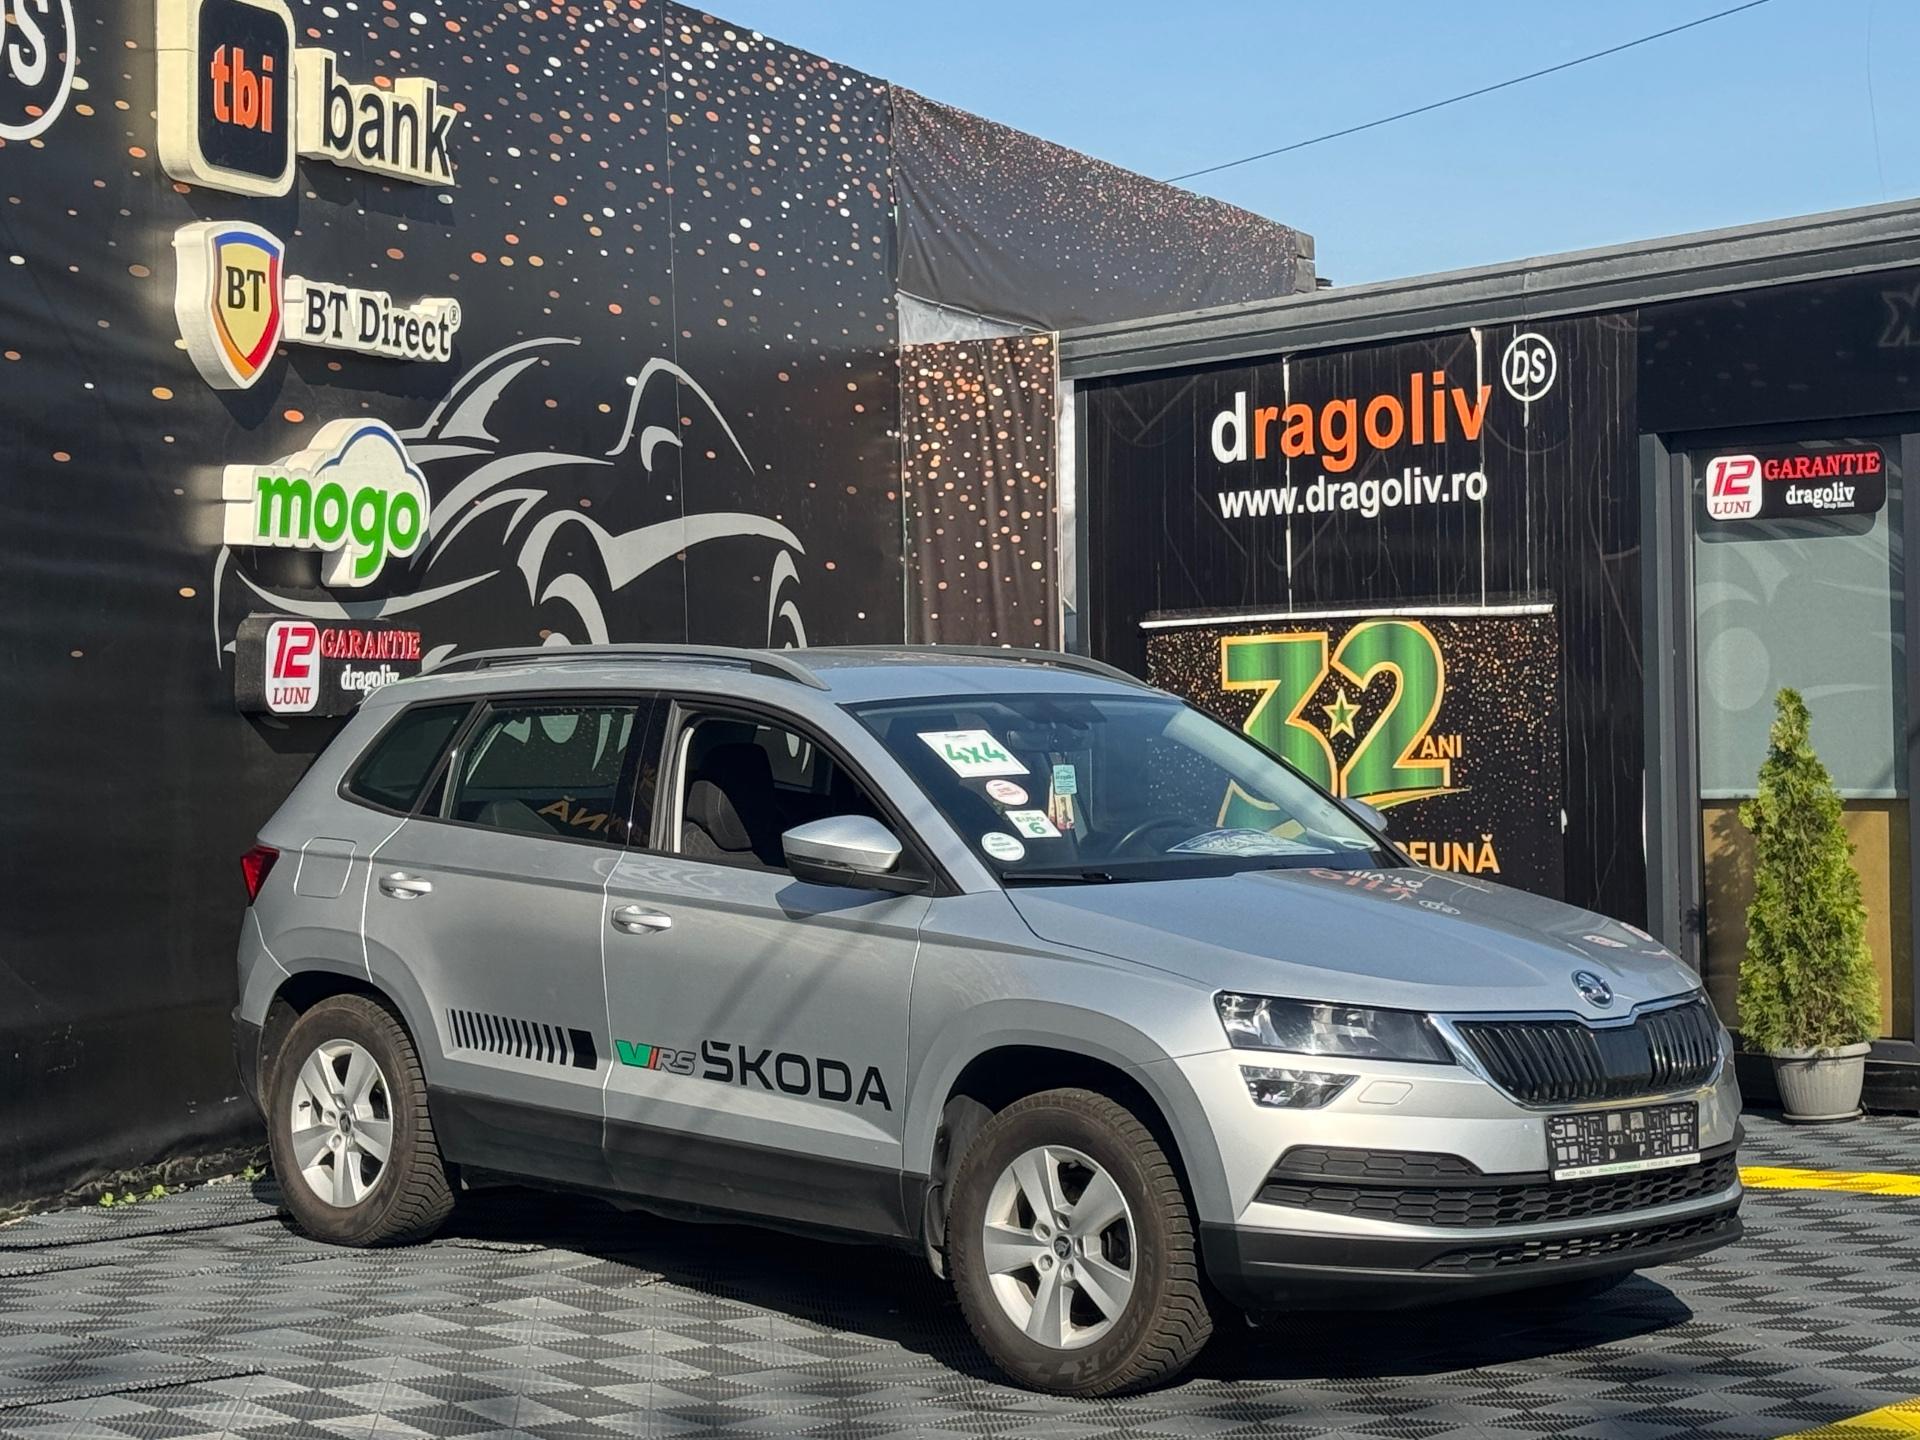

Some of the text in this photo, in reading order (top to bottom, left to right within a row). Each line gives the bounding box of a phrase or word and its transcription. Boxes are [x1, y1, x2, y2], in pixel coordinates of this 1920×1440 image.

[210, 44, 453, 178] tbi bank
[226, 266, 266, 312] BT
[305, 288, 348, 338] BT
[1511, 350, 1546, 386] DS
[1211, 370, 1493, 472] dragoliv
[1218, 467, 1488, 519] www.dragoliv.ro
[1712, 452, 1881, 497] 12 GARANTIE
[1785, 482, 1855, 509] dragoliv
[257, 476, 420, 578] mogo
[1713, 501, 1752, 515] LUNI
[272, 627, 421, 679] 12 GARANTIE
[273, 687, 311, 705] LUNI
[1221, 617, 1451, 799] 32
[1421, 734, 1462, 759] ANI
[1029, 822, 1047, 835] 6
